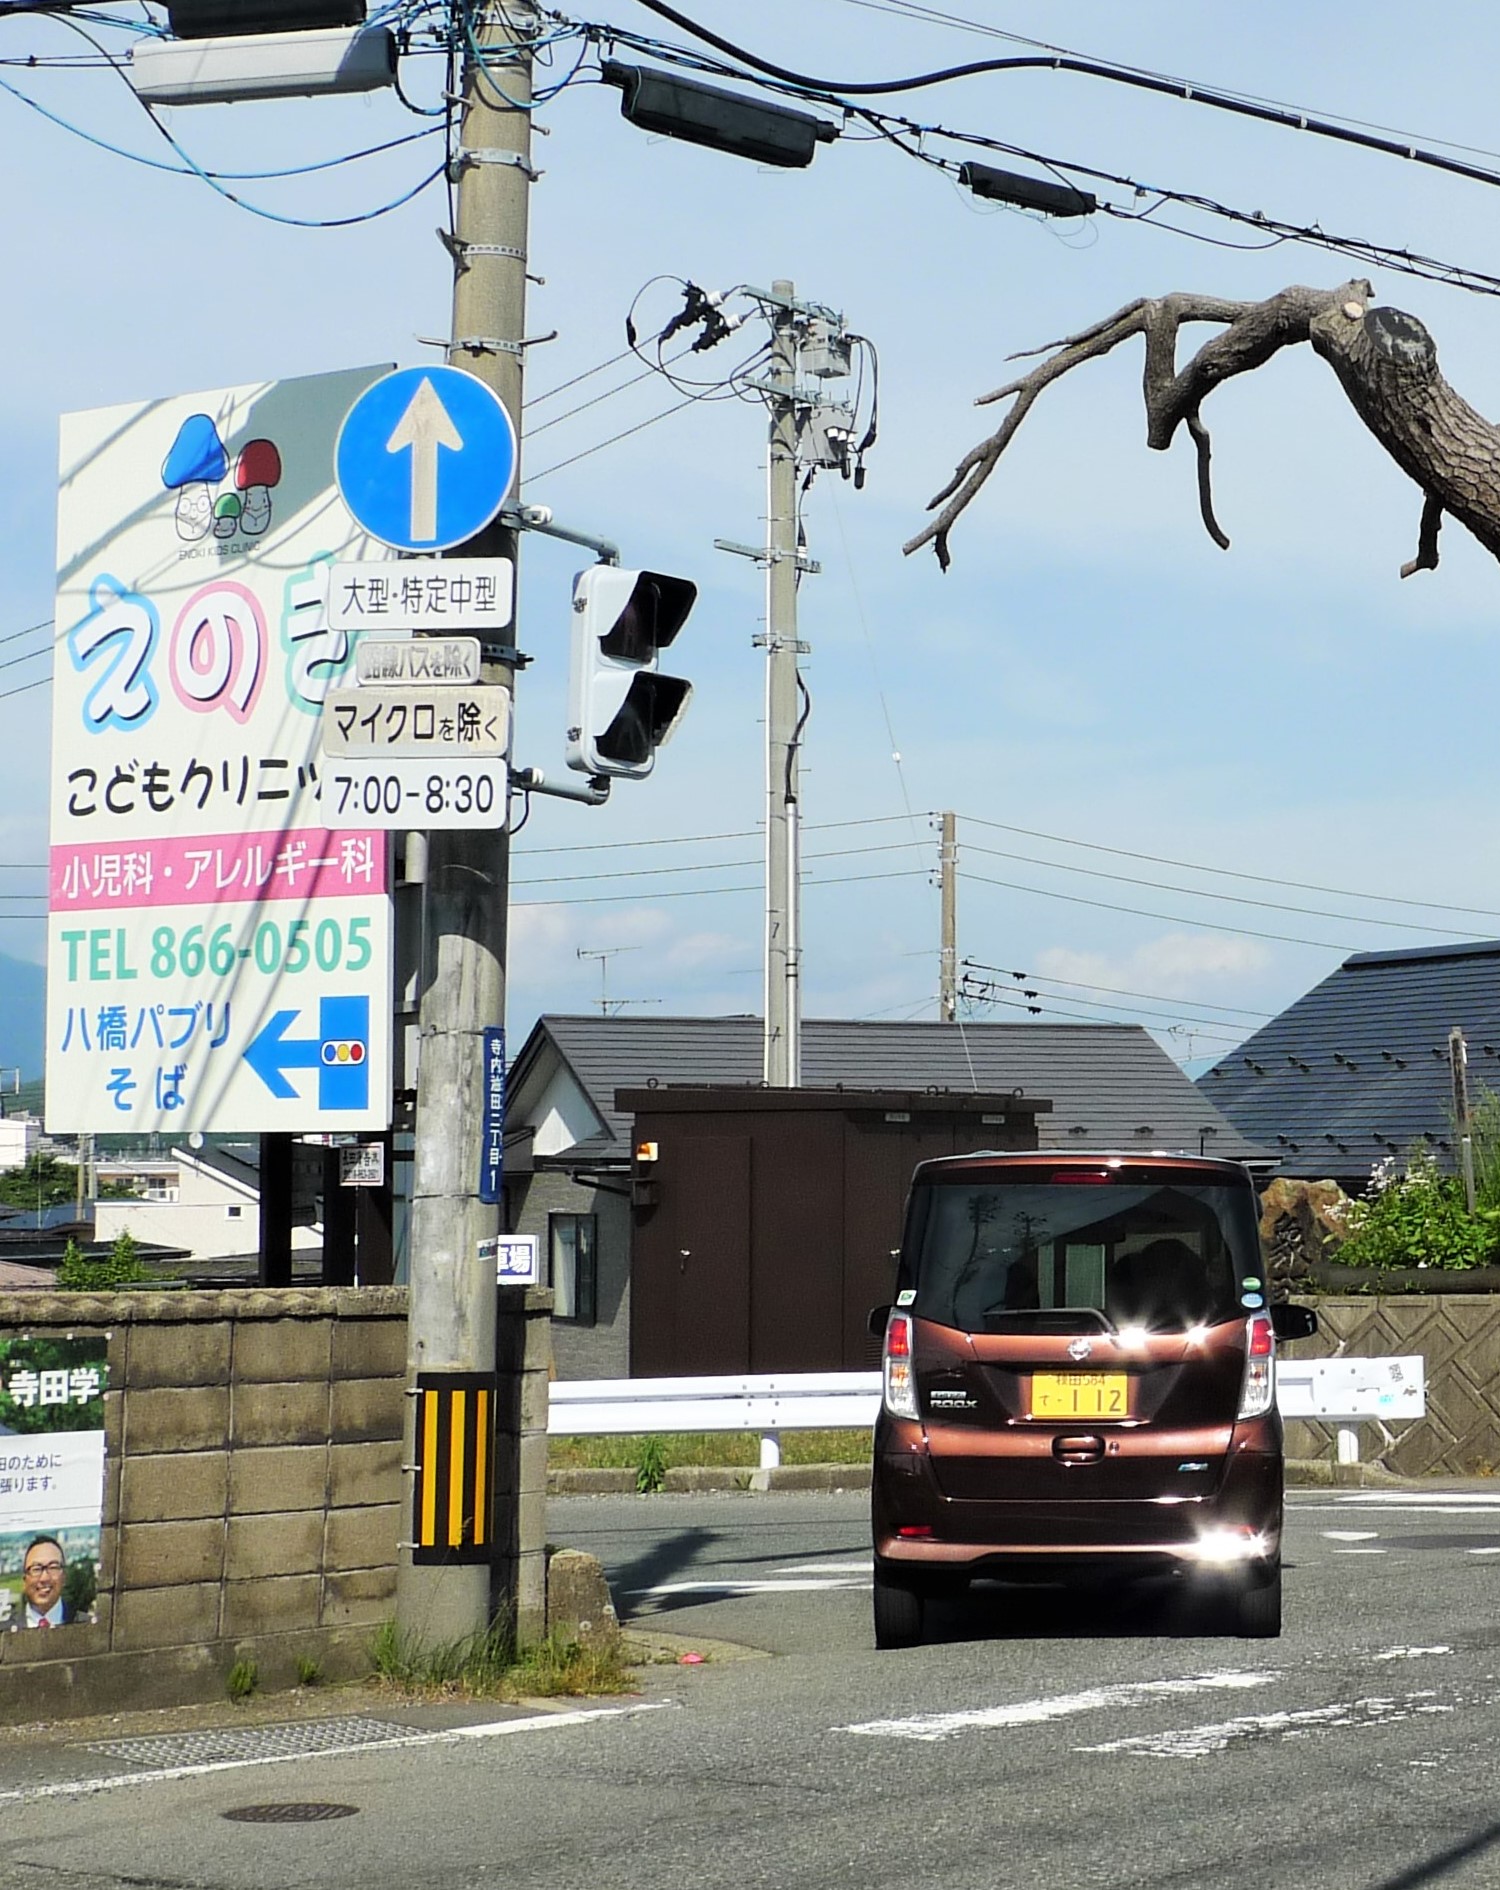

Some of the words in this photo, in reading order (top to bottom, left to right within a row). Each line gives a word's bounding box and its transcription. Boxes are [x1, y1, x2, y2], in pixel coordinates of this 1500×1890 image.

[342, 574, 497, 615] 大型・特定中型
[334, 702, 498, 744] マイクロを除く
[334, 774, 494, 815] 7:00-8:30
[61, 837, 374, 900] 小児科・アレルギー科
[61, 928, 138, 982] TEL
[150, 917, 373, 979] 866-0505
[61, 1000, 232, 1052] 八橋パブリ
[106, 1063, 188, 1112] そば
[8, 1367, 100, 1407] 寺田学
